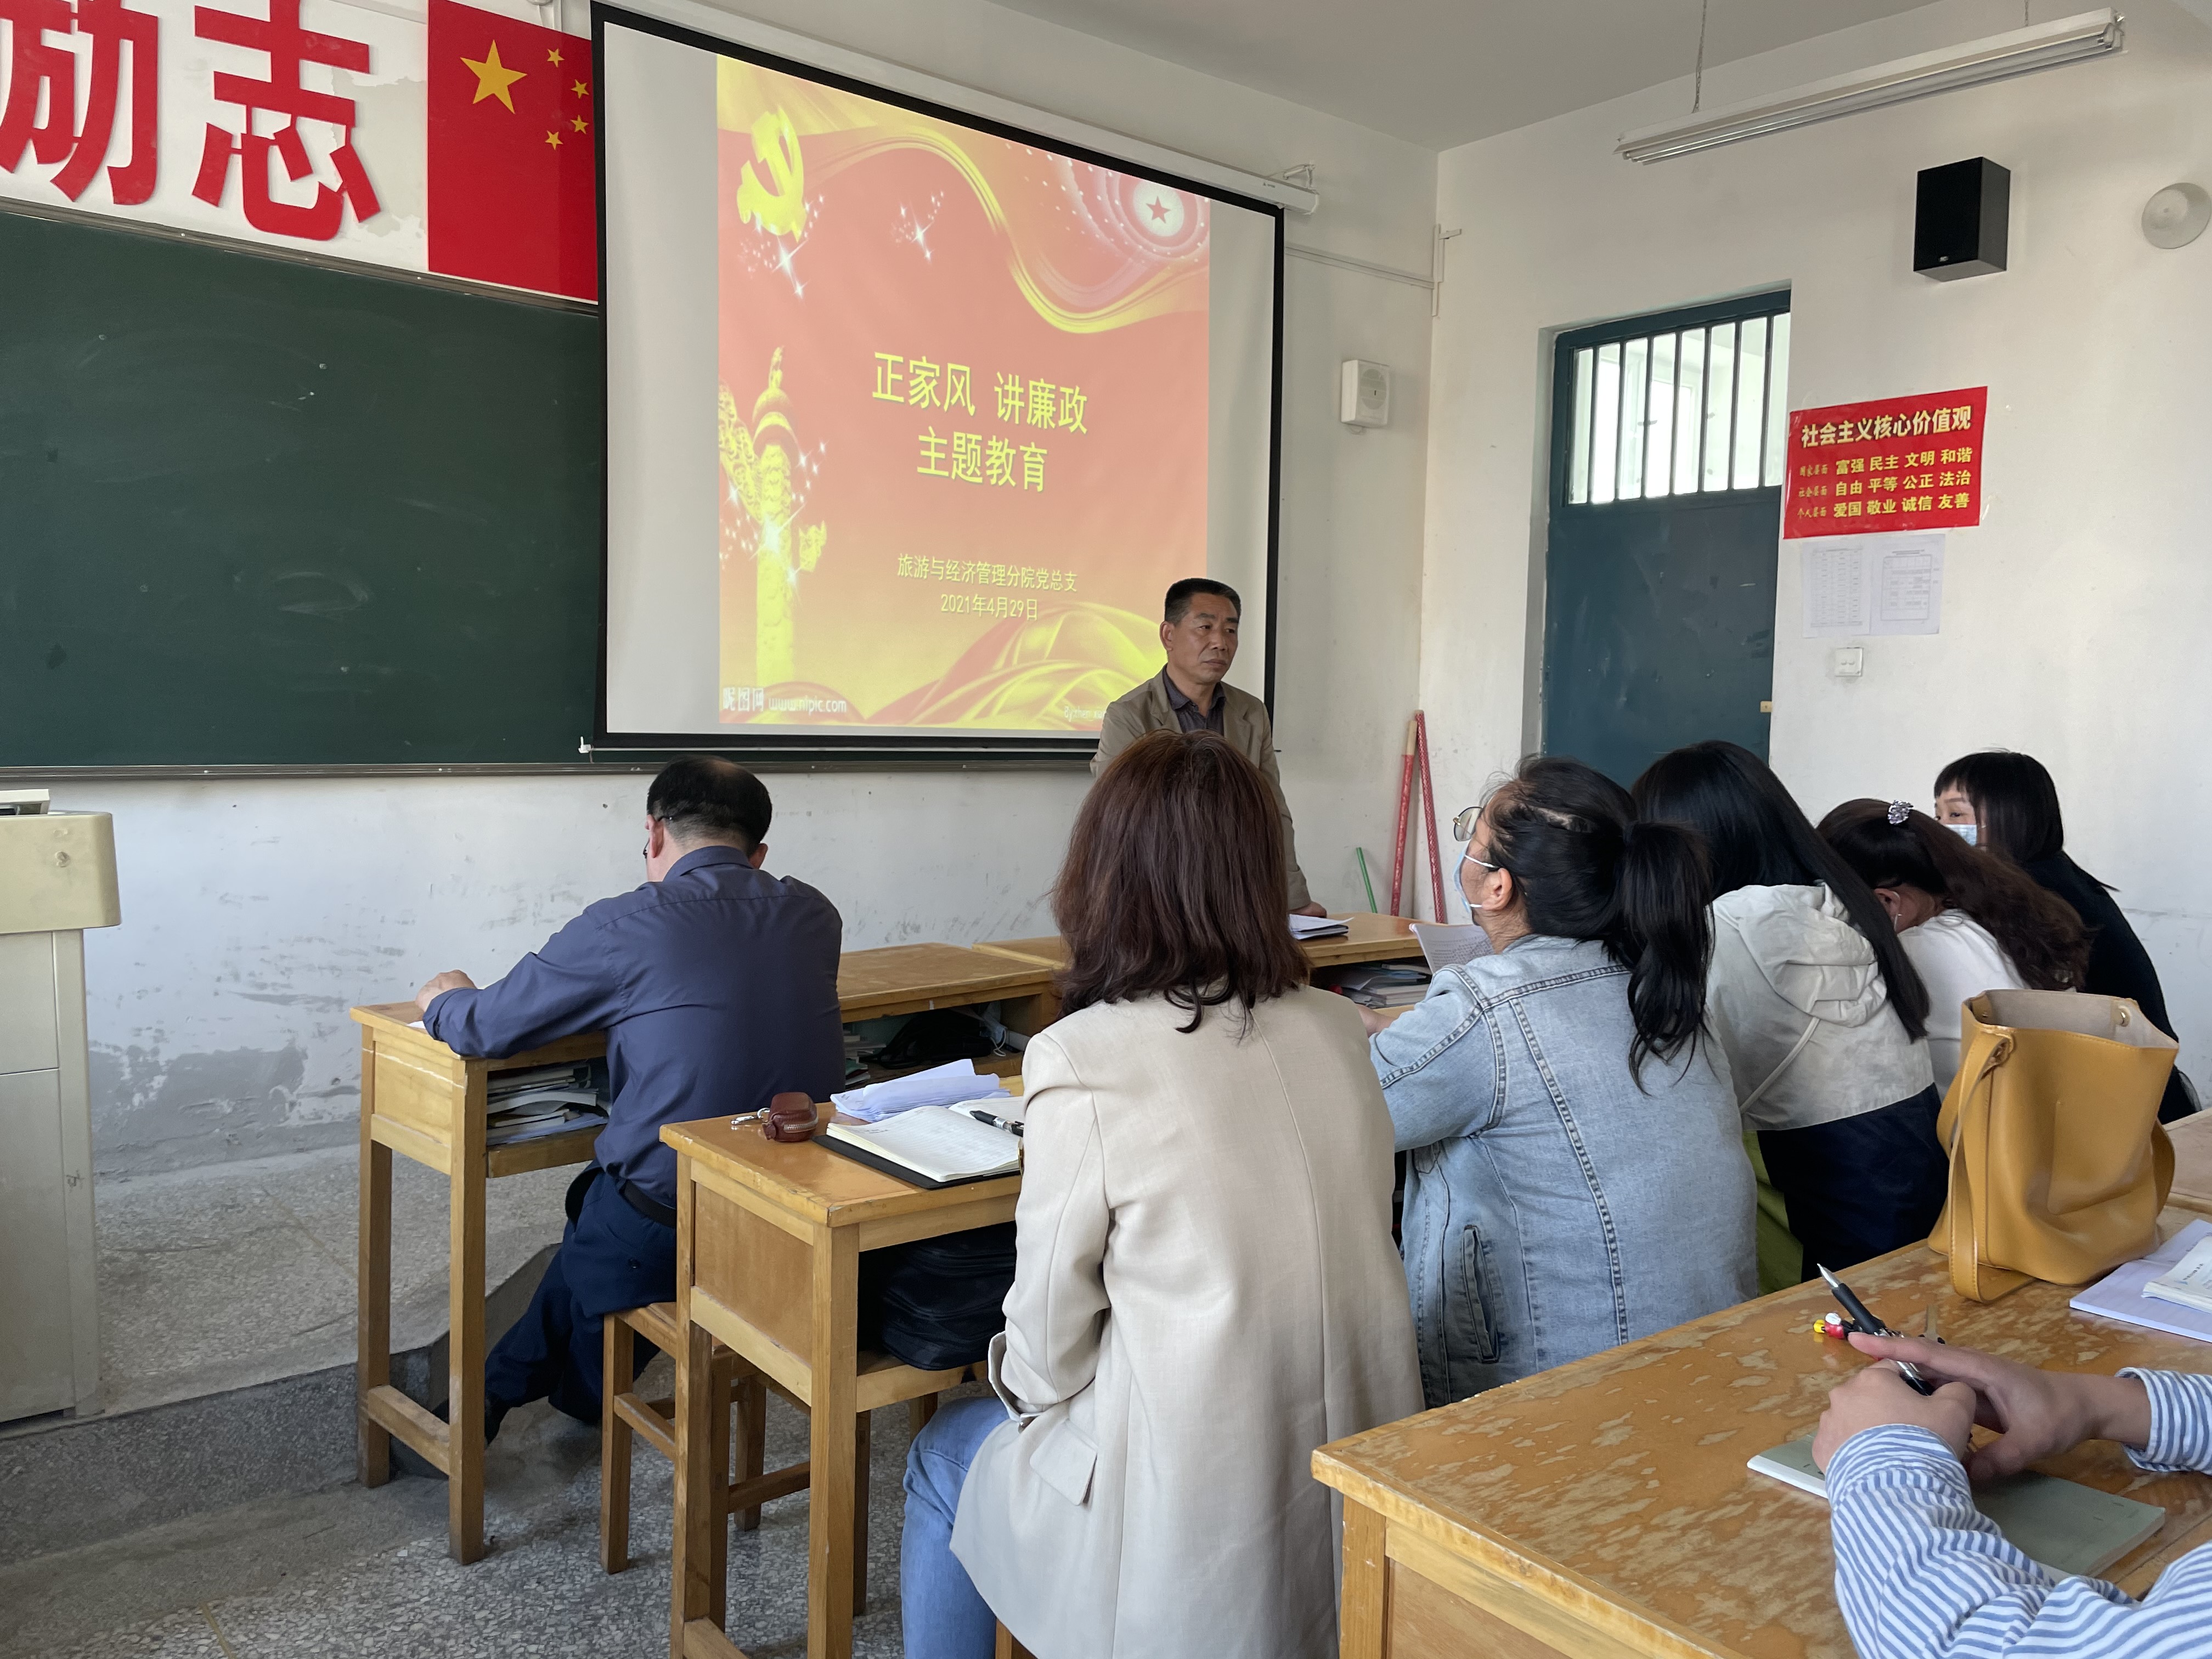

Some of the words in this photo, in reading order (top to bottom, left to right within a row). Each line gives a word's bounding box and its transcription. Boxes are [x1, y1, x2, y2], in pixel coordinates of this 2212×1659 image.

[872, 352, 976, 416] 正家风
[994, 371, 1087, 434] 讲廉政
[1801, 405, 1972, 448] 社会主义核心价值观
[917, 426, 1048, 492] 主题教育
[1836, 458, 1865, 475] 富强
[1870, 455, 1899, 471] 民主
[1904, 450, 1935, 467] 文明
[1940, 447, 1973, 464] 和谐
[1836, 480, 1863, 496] 自由
[1867, 476, 1898, 493] 平等
[1903, 473, 1934, 490] 公正
[1939, 470, 1972, 487] 法治
[1833, 501, 1862, 518] 爱国
[1866, 499, 1897, 515] 敬业
[1901, 495, 1933, 512] 诚信
[1938, 492, 1970, 510] 友善
[897, 553, 1078, 592] 旅游与经济管理分院党总支
[940, 593, 1038, 621] 2021年4月29日
